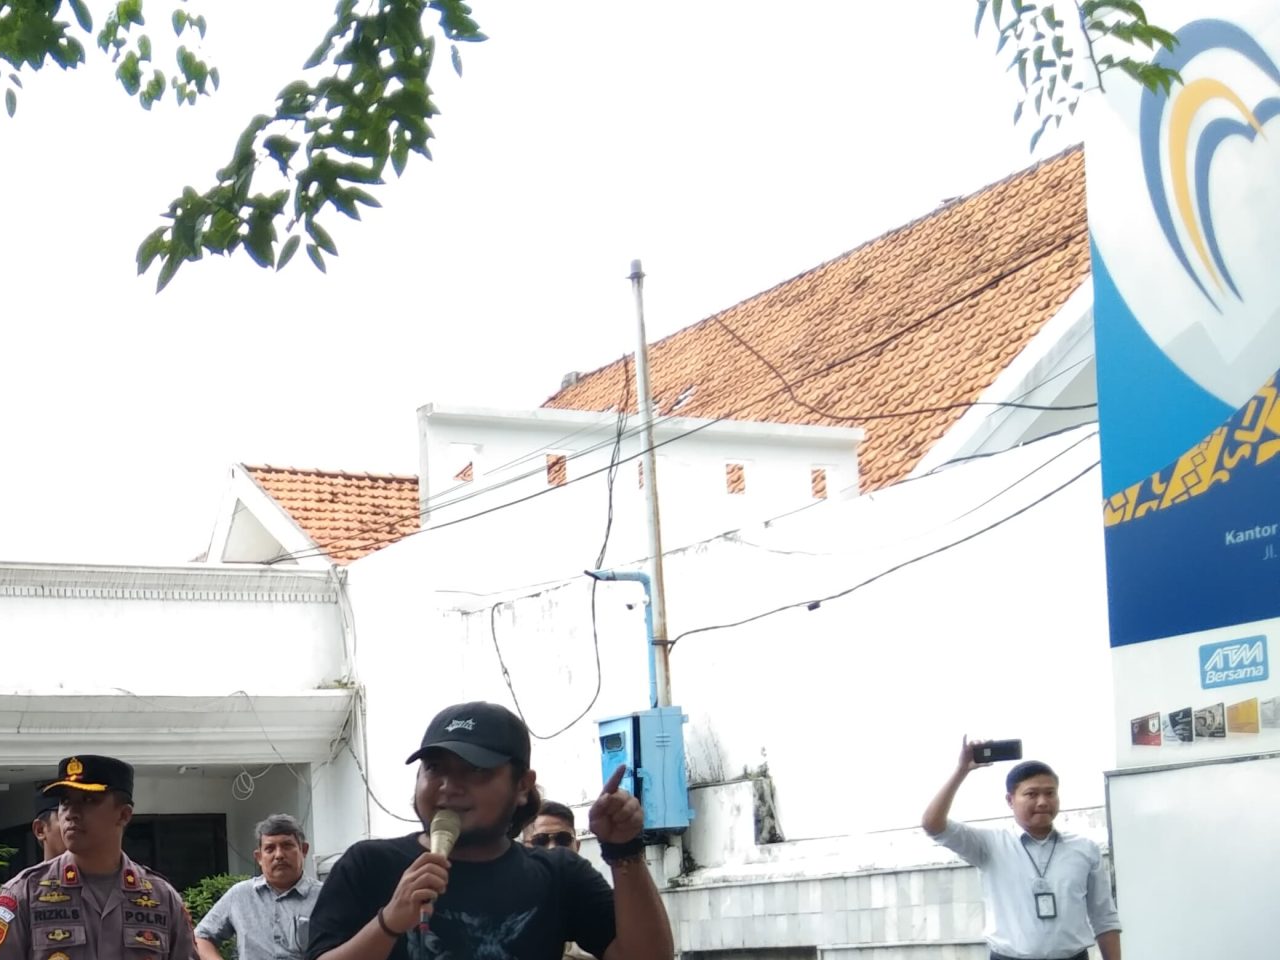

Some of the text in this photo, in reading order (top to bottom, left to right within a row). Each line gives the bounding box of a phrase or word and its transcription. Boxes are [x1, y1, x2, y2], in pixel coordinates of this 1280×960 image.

[1225, 524, 1278, 545] Kantor
[1204, 640, 1263, 671] ATM
[1205, 664, 1263, 684] Bersama
[125, 911, 167, 926] POLRI
